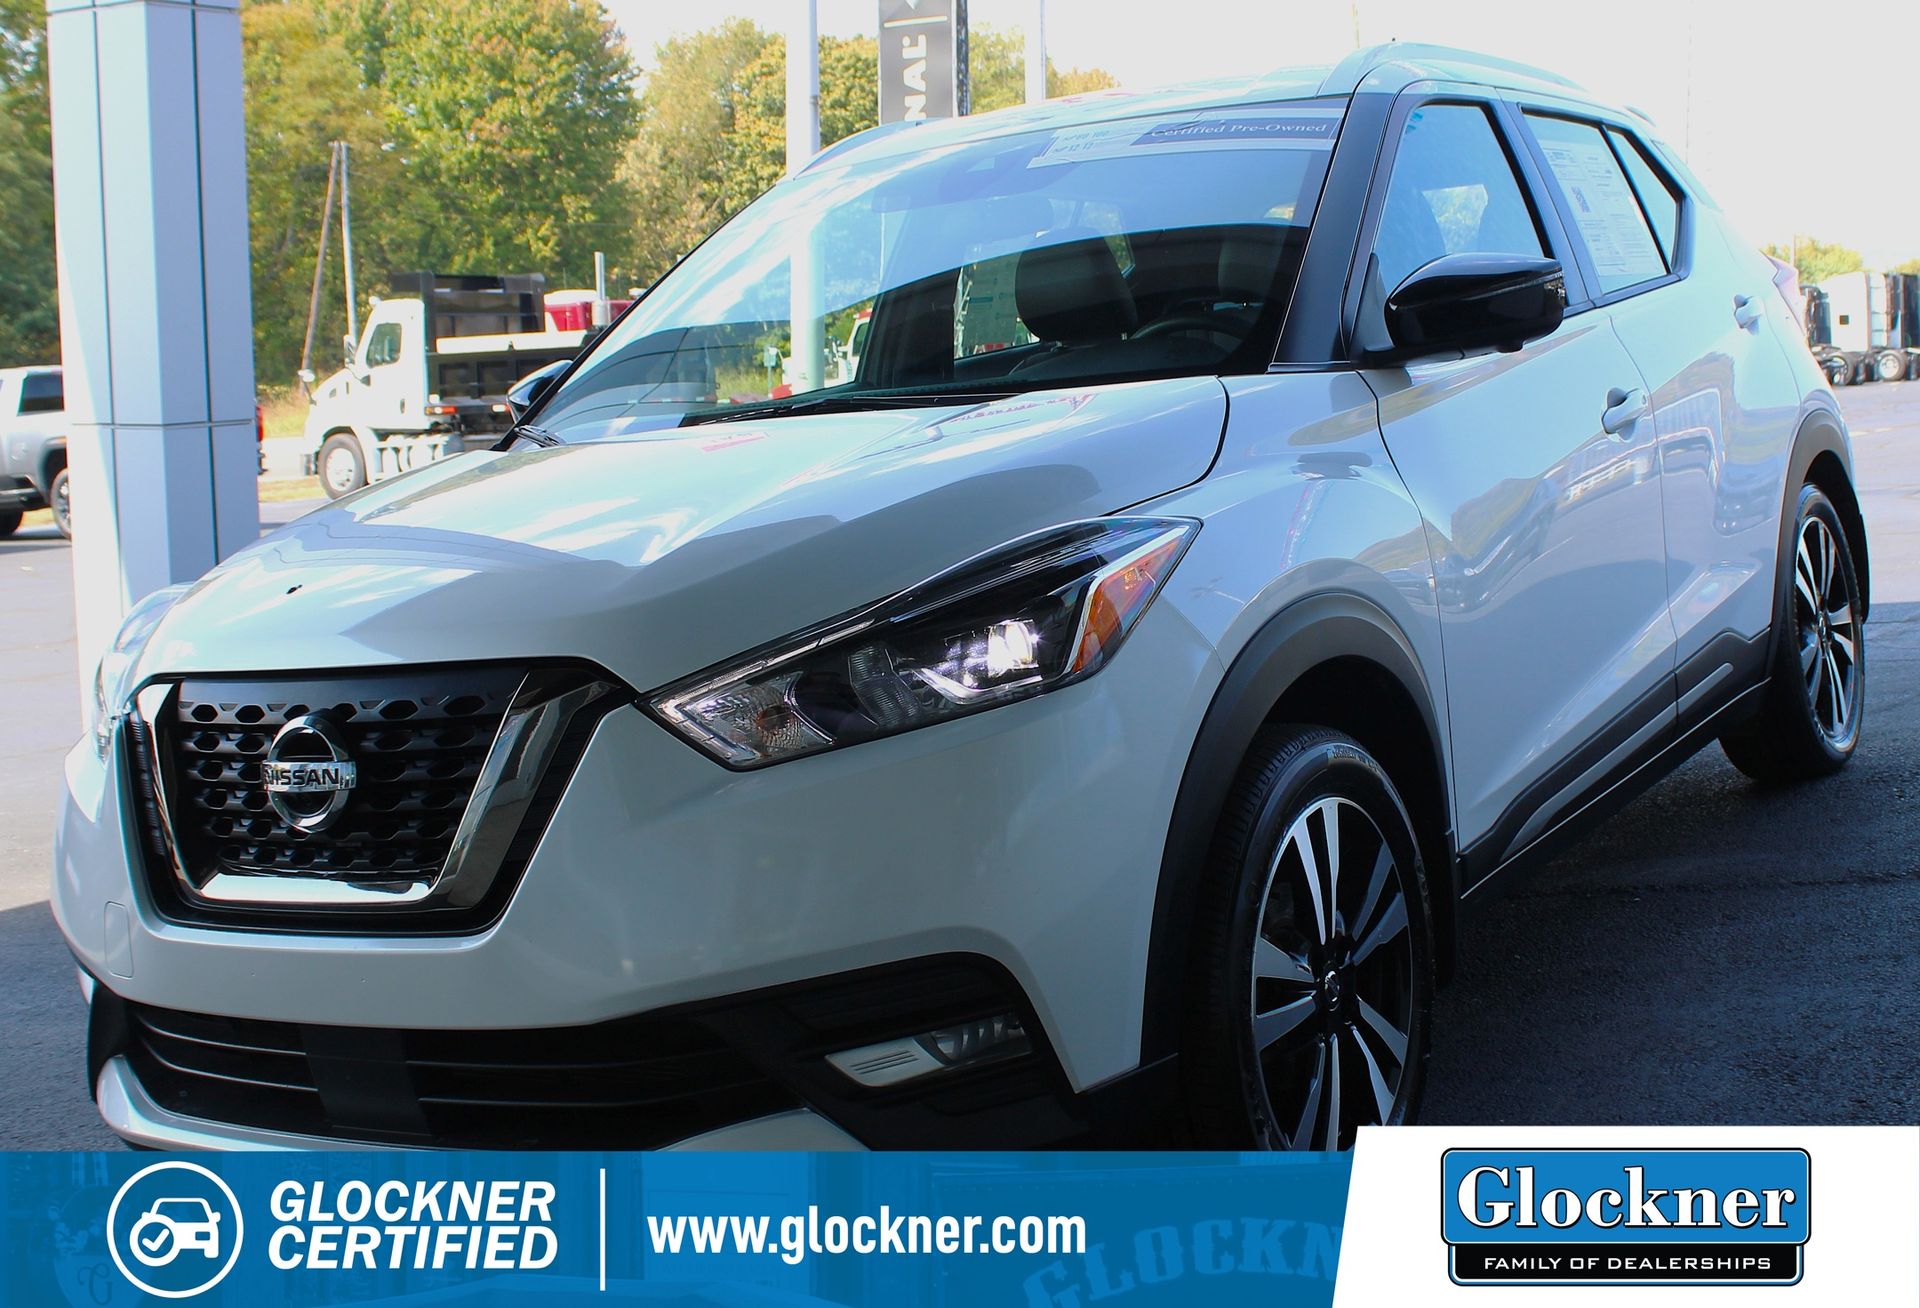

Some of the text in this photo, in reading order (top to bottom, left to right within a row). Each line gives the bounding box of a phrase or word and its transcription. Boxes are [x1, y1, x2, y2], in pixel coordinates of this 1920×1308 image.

[1152, 120, 1327, 137] Certified Pre-Owned
[264, 767, 339, 786] NISSAN
